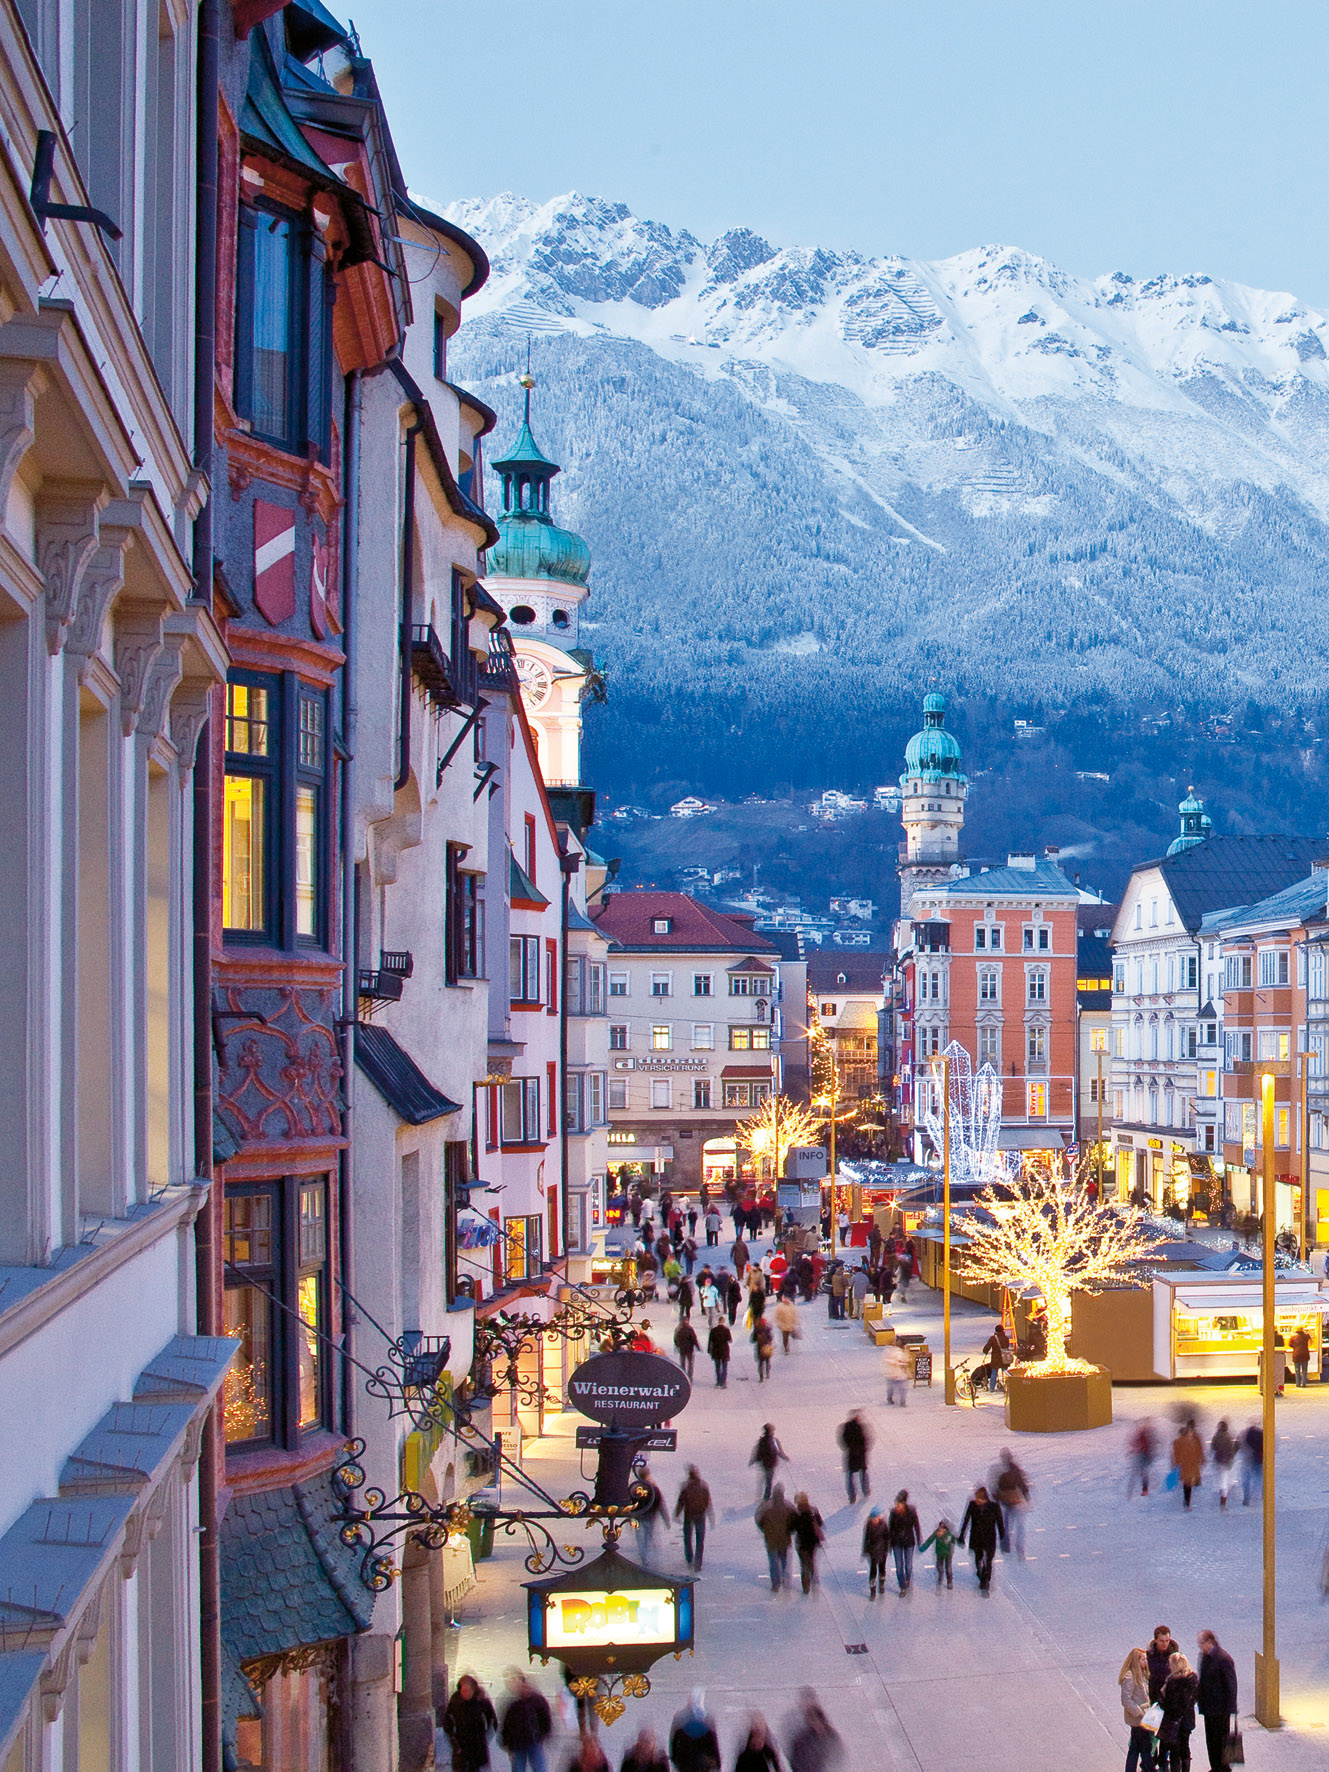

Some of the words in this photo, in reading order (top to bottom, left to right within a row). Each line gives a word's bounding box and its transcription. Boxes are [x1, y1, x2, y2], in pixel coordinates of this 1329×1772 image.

[639, 1056, 708, 1064] donau
[638, 1064, 709, 1072] VERSICHERUNG
[799, 1151, 824, 1160] INFO
[594, 1400, 660, 1410] RESTAURANT
